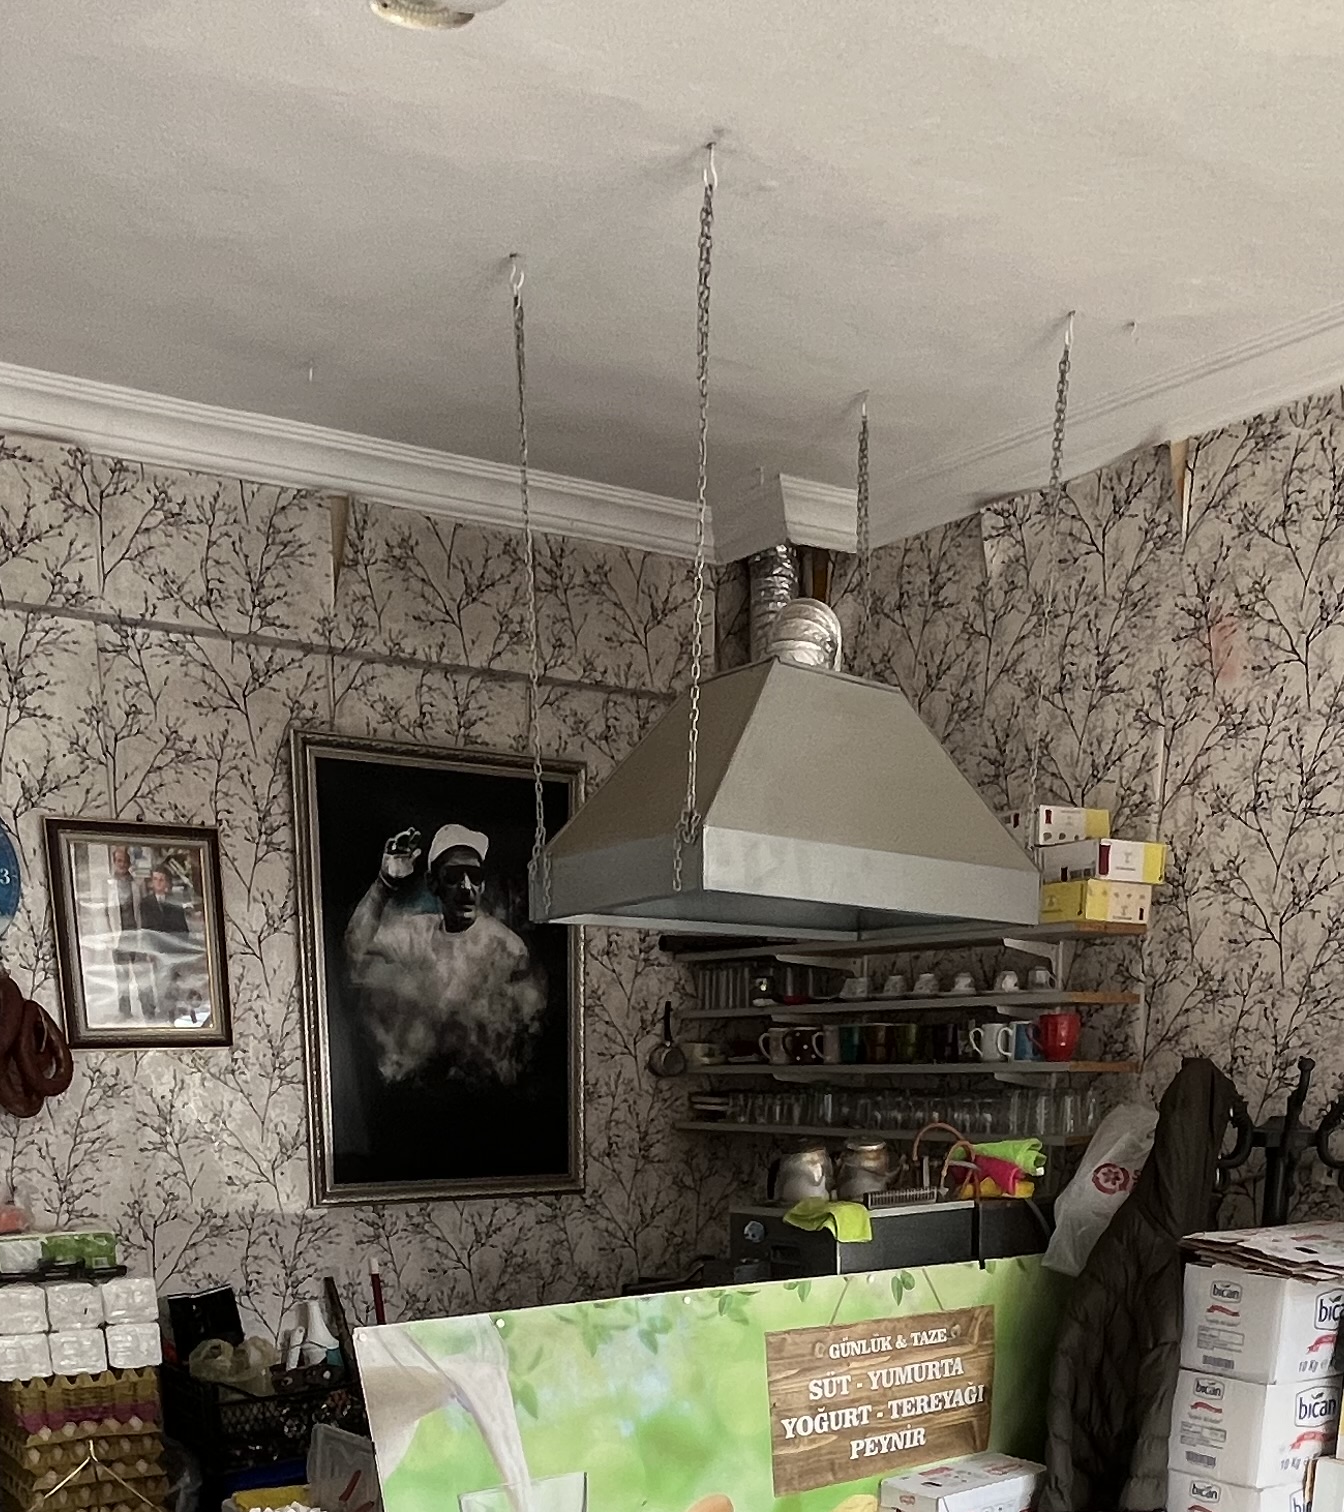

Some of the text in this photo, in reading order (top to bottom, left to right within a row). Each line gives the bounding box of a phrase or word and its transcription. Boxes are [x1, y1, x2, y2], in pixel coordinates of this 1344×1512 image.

[0, 868, 11, 885] 3
[1212, 1283, 1240, 1300] bican
[828, 1328, 947, 1360] GÜNLÜK & TAZE
[808, 1370, 852, 1401] SÜT
[867, 1357, 964, 1391] YUMURTA
[780, 1405, 873, 1440] YOĞURT
[887, 1381, 985, 1420] TEREYAĞI
[1298, 1396, 1337, 1420] bican
[849, 1423, 927, 1460] PEYNİR
